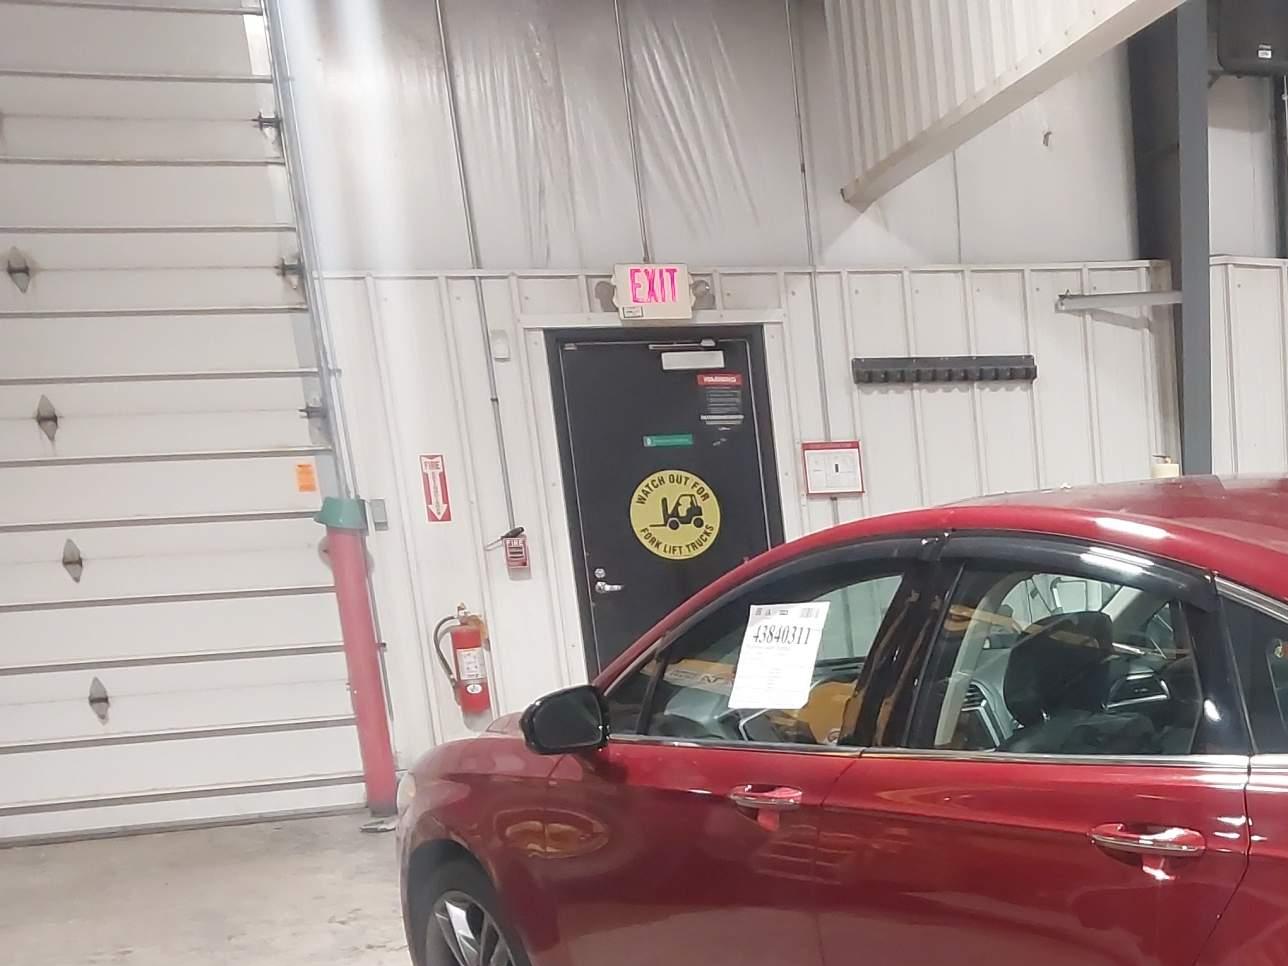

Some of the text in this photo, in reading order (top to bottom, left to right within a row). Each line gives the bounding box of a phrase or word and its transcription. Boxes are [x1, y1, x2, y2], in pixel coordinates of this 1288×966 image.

[629, 268, 677, 303] EXIT
[636, 473, 711, 505] WATCH OUT FOR
[640, 524, 714, 555] FORK LIFT TRUCKS
[752, 624, 812, 645] 43840311
